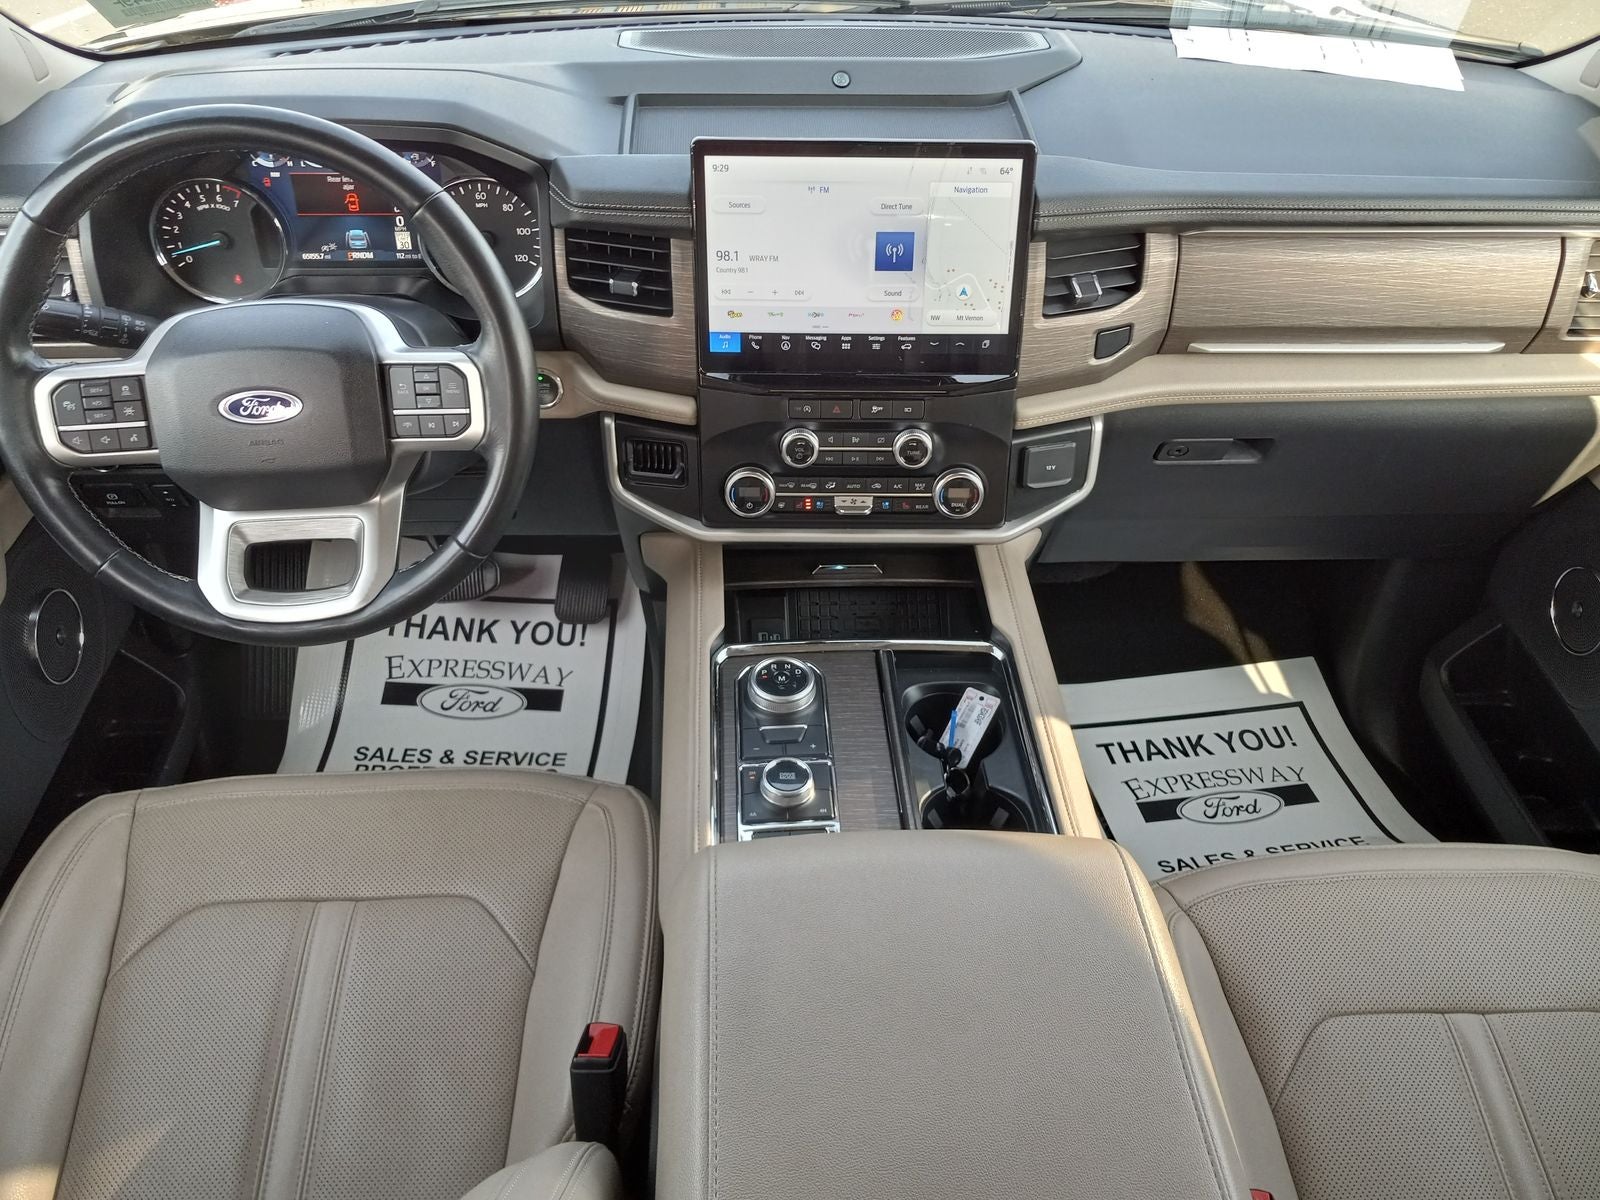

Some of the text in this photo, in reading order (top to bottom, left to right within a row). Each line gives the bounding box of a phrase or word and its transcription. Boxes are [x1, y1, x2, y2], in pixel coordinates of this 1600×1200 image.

[712, 164, 729, 173] 9:29
[999, 167, 1014, 176] 64°
[954, 186, 988, 194] Navigation
[200, 195, 206, 203] 5
[216, 194, 222, 202] 6
[475, 192, 487, 200] 60
[184, 201, 191, 209] 4
[233, 200, 239, 208] 7
[502, 203, 514, 212] 80
[728, 201, 751, 209] Sources
[176, 212, 183, 220] 3
[395, 215, 405, 227] 0
[173, 226, 180, 234] 2
[516, 227, 531, 236] 100
[178, 241, 182, 249] 1
[399, 241, 410, 249] 30
[185, 255, 193, 263] 0
[514, 254, 529, 262] 120
[716, 250, 739, 262] 98.1
[716, 266, 737, 274] Country
[240, 397, 286, 416] Ford
[511, 619, 588, 646] YOU!
[385, 655, 574, 688] EXPRESSWAY
[440, 688, 503, 714] Ford
[1095, 724, 1298, 766] THANK YOU!
[353, 746, 568, 767] SALES & SERVICE
[1121, 765, 1305, 801] EXPRESSWAY
[1203, 795, 1262, 819] Ford
